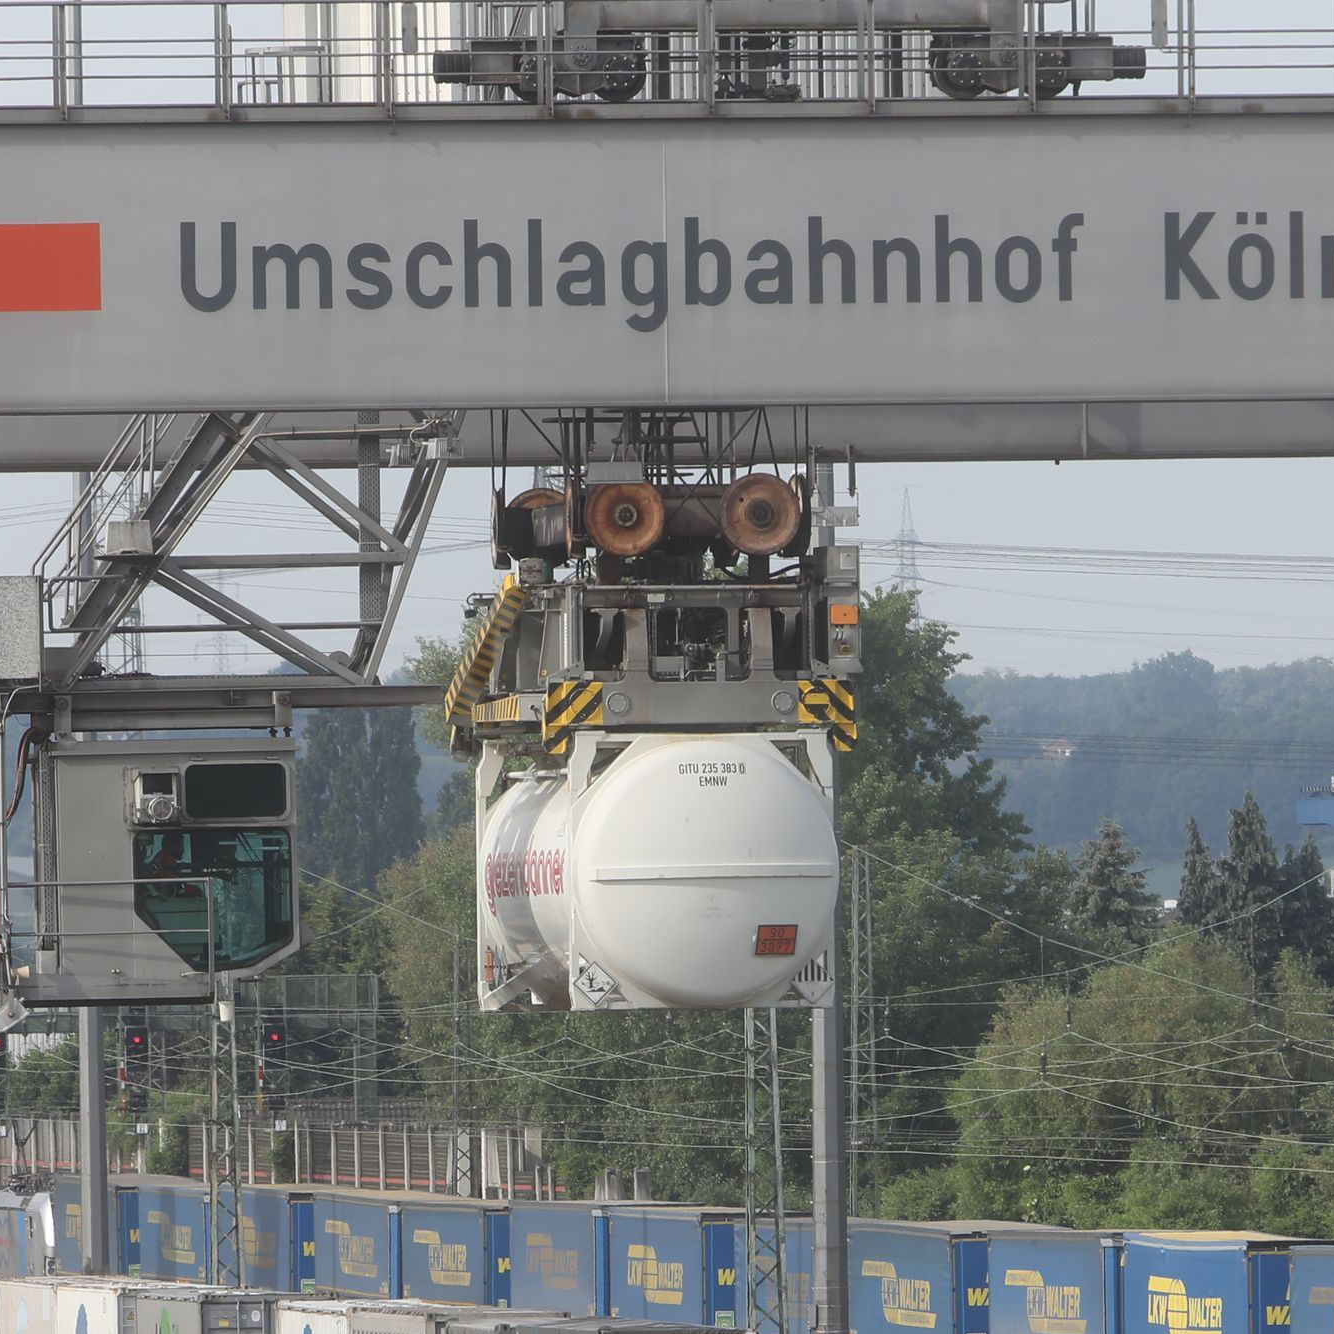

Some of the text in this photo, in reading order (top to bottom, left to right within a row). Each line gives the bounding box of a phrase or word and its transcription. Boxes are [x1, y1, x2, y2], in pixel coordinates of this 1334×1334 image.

[178, 212, 1084, 334] Umschlagbahnhof
[678, 763, 699, 775] GITU
[701, 762, 718, 774] 235
[720, 762, 737, 773] 383
[699, 776, 728, 787] EMNW
[627, 1259, 683, 1289] LKW WALTER
[899, 1279, 931, 1311] WALTER
[1046, 1285, 1081, 1318] WALTER
[1147, 1293, 1223, 1329] LKW WALTER
